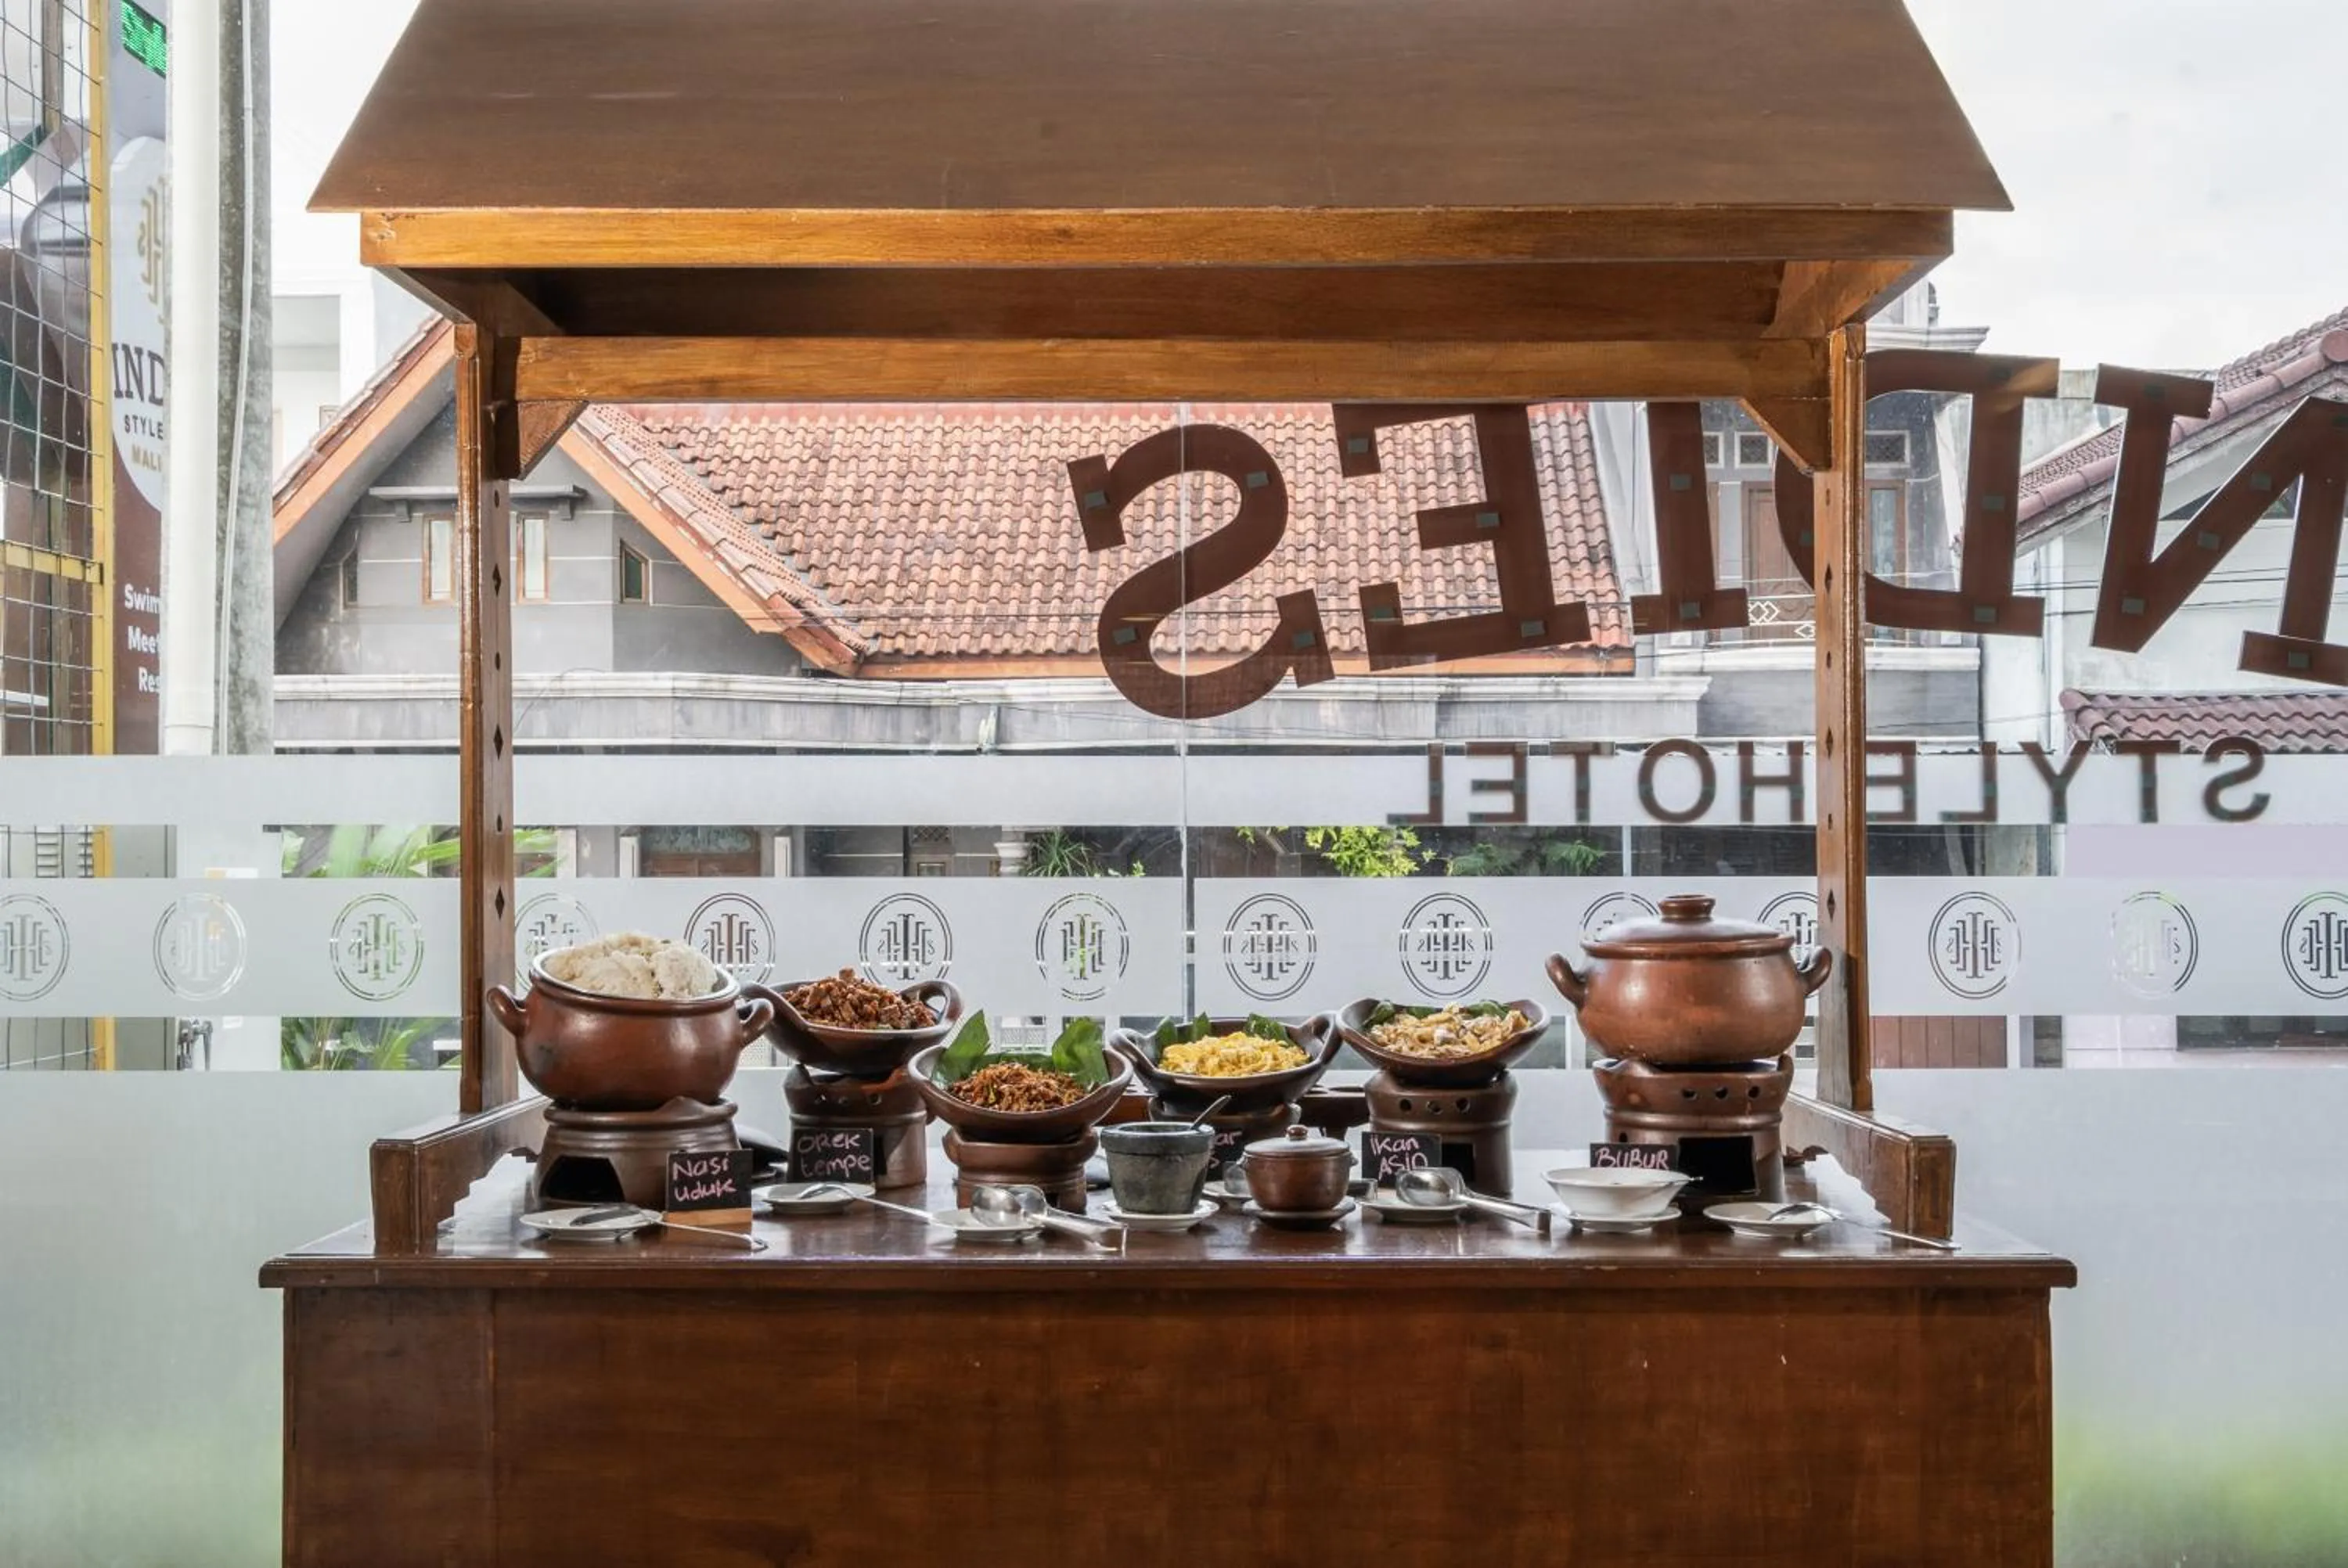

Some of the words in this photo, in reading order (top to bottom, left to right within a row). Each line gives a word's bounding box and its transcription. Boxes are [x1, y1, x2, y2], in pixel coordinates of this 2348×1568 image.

[124, 414, 164, 441] STYLE
[128, 625, 160, 655] Mee
[672, 1152, 729, 1181] Nasi
[1595, 1146, 1669, 1170] BUBUR
